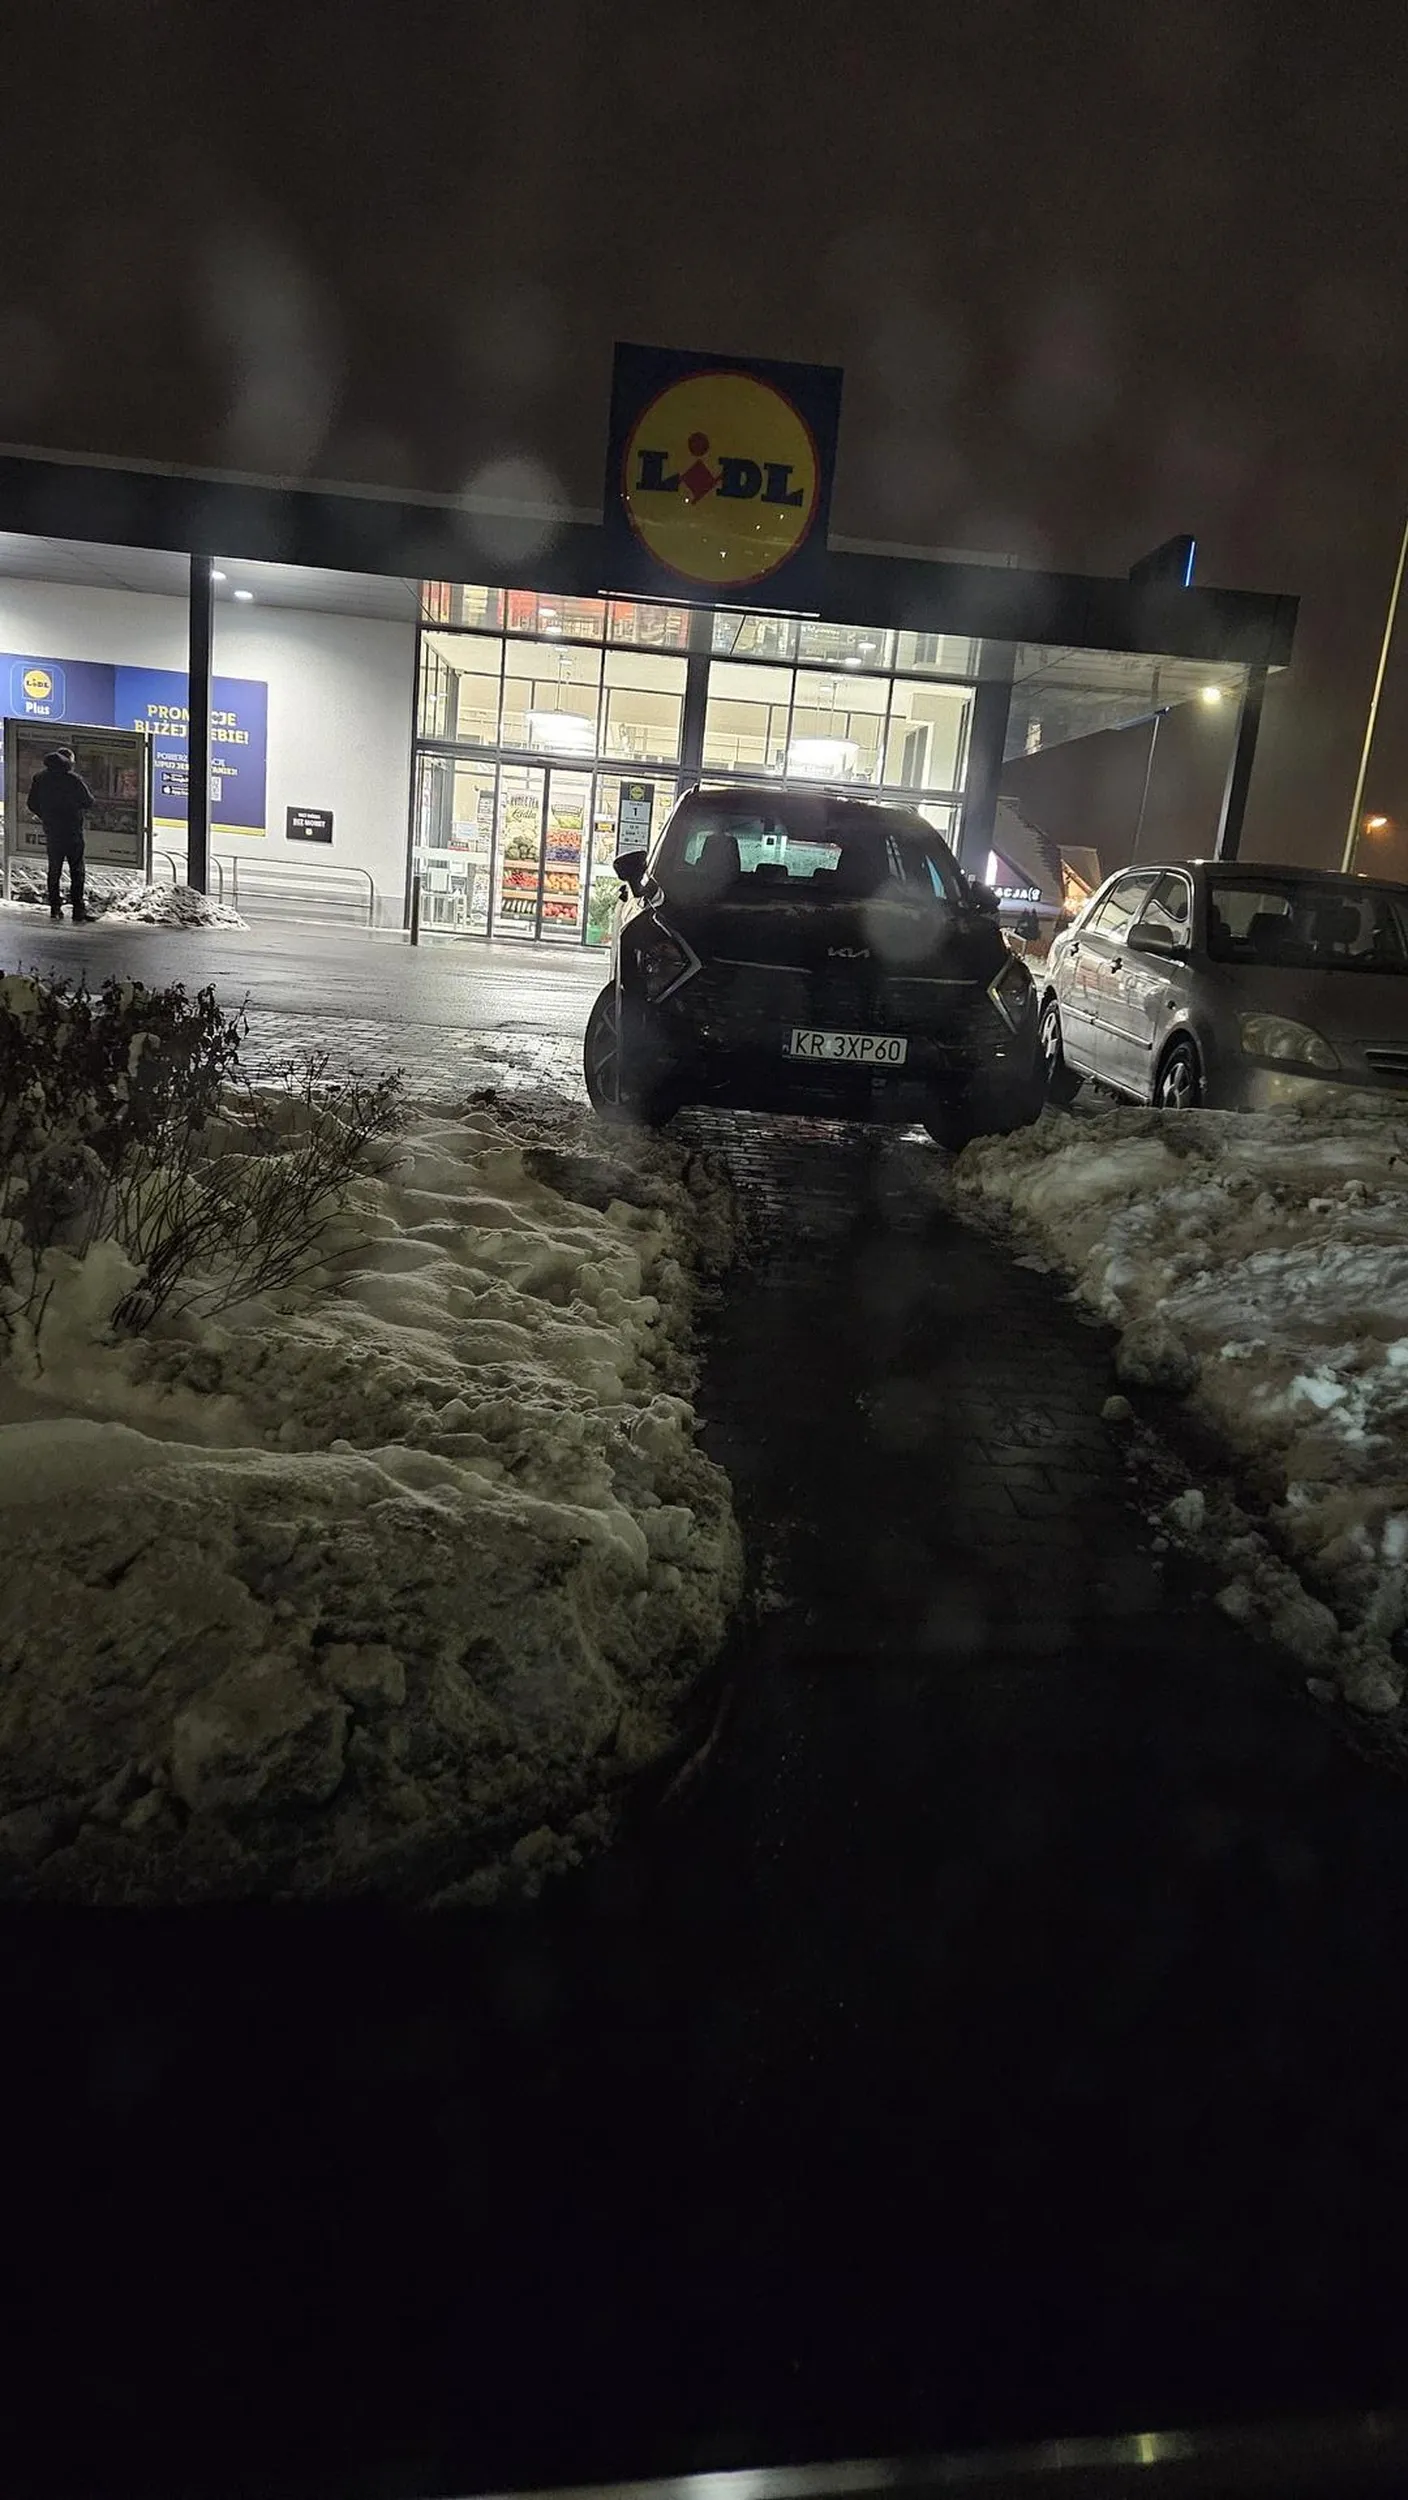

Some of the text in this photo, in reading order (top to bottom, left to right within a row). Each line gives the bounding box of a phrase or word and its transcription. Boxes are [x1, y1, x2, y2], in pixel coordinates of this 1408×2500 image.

[25, 701, 50, 715] Plus
[147, 704, 237, 727] PROMCJE
[210, 728, 249, 745] EBIE!
[796, 1032, 901, 1061] KR 3XP60
